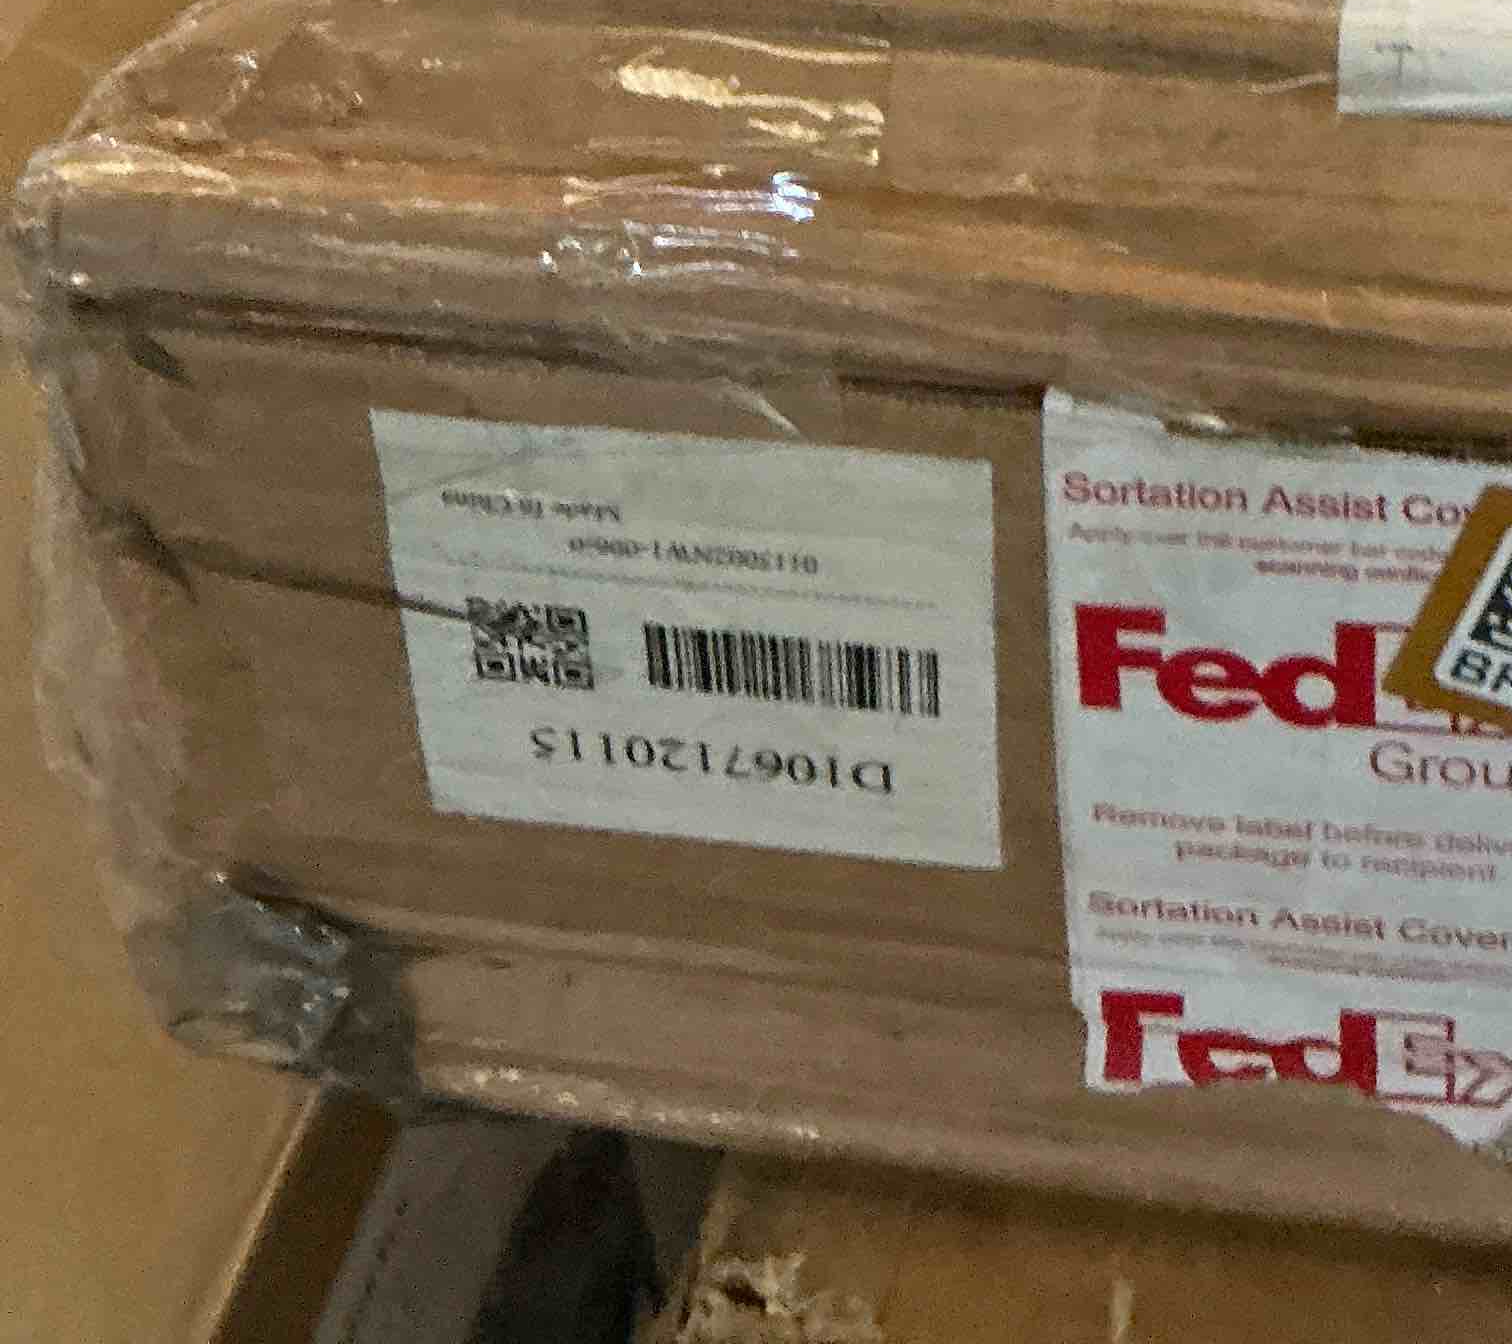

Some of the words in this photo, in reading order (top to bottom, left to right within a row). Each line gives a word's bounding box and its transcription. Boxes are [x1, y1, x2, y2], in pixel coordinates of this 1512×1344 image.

[1061, 470, 1249, 514] Sortation
[1261, 483, 1388, 521] Assist
[530, 727, 892, 795] D1067120115
[1092, 802, 1226, 834] Remove
[1235, 813, 1314, 841] label
[1321, 821, 1426, 850] before
[1174, 839, 1312, 872] package
[1321, 852, 1351, 870] to
[1087, 889, 1260, 929] Sortation
[1271, 906, 1387, 941] Assist
[1397, 915, 1511, 950] Cover
